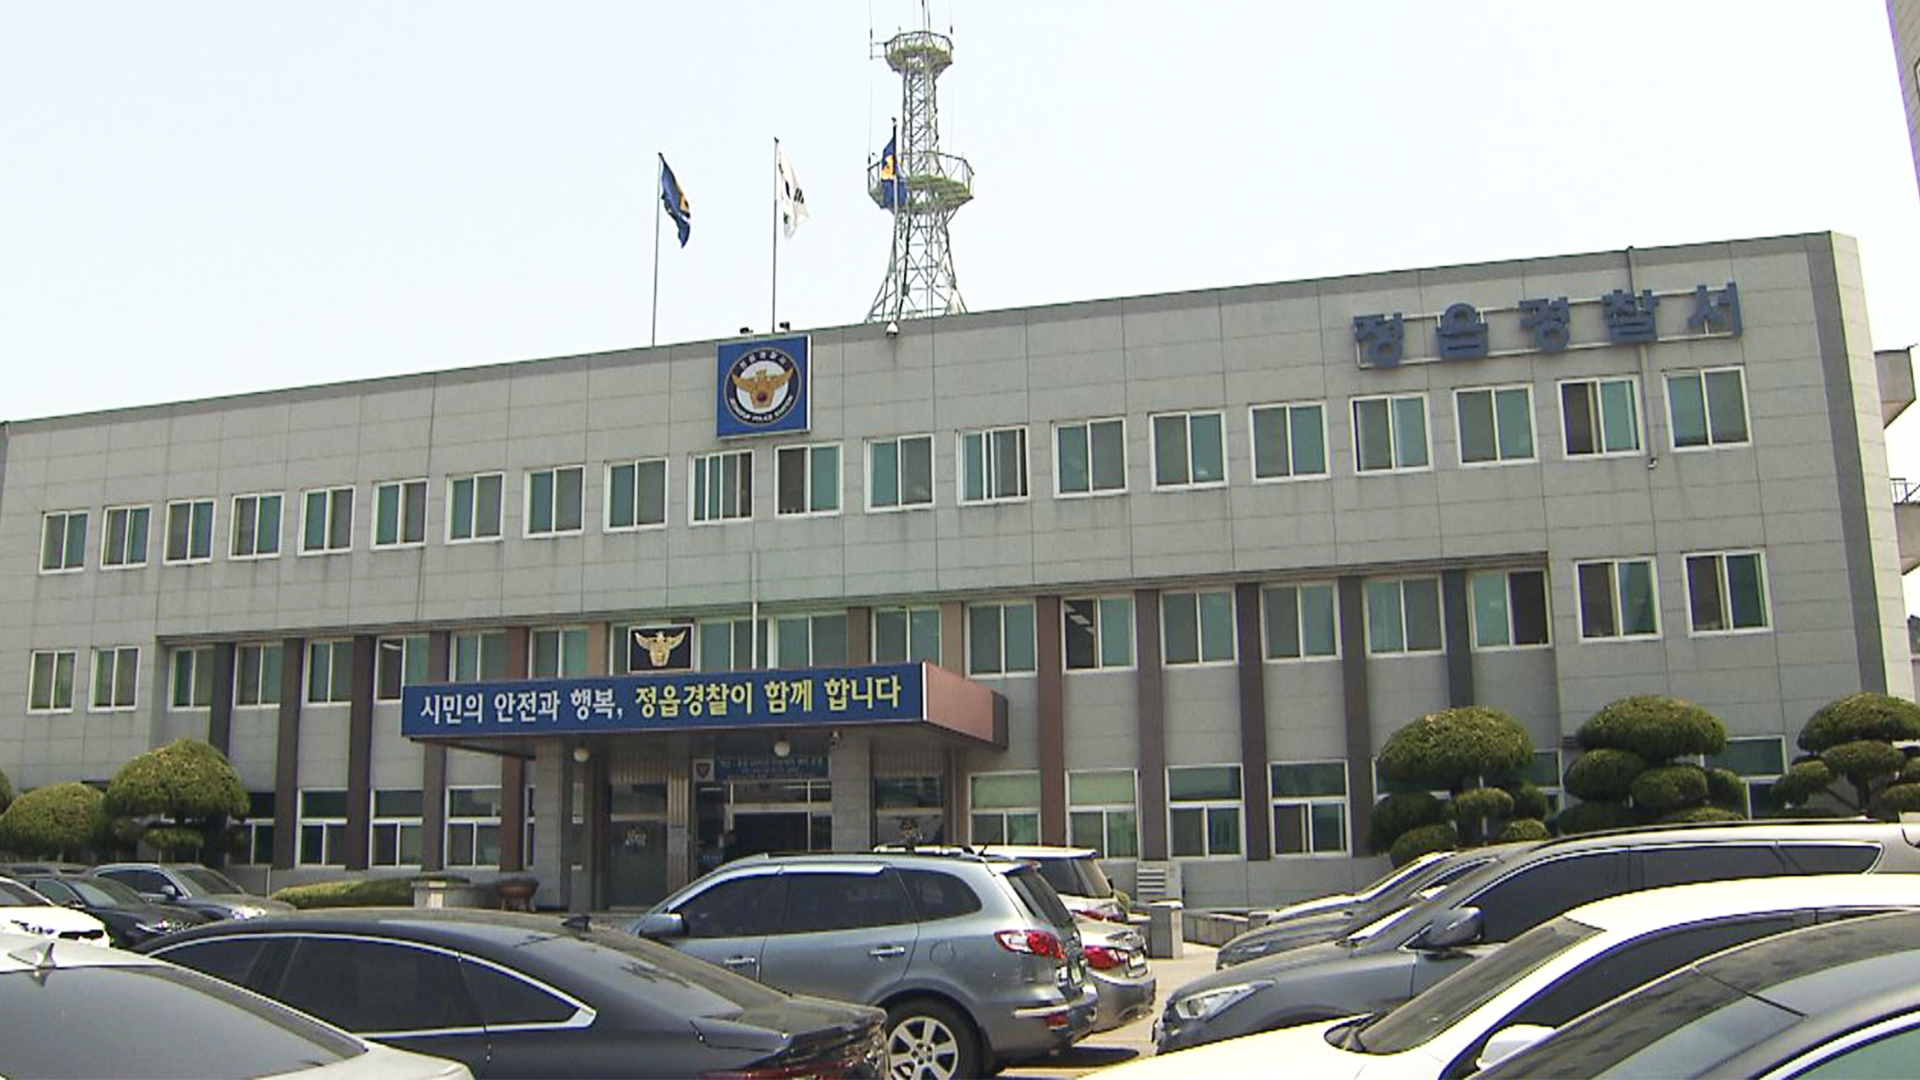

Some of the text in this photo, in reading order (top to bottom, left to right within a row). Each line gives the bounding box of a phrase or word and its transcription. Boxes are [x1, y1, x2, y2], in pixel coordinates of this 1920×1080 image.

[1353, 282, 1742, 367] 정읍경찰서
[421, 675, 901, 724] 시민의 안전과 행복, 정읍경찰이 함께 합니다
